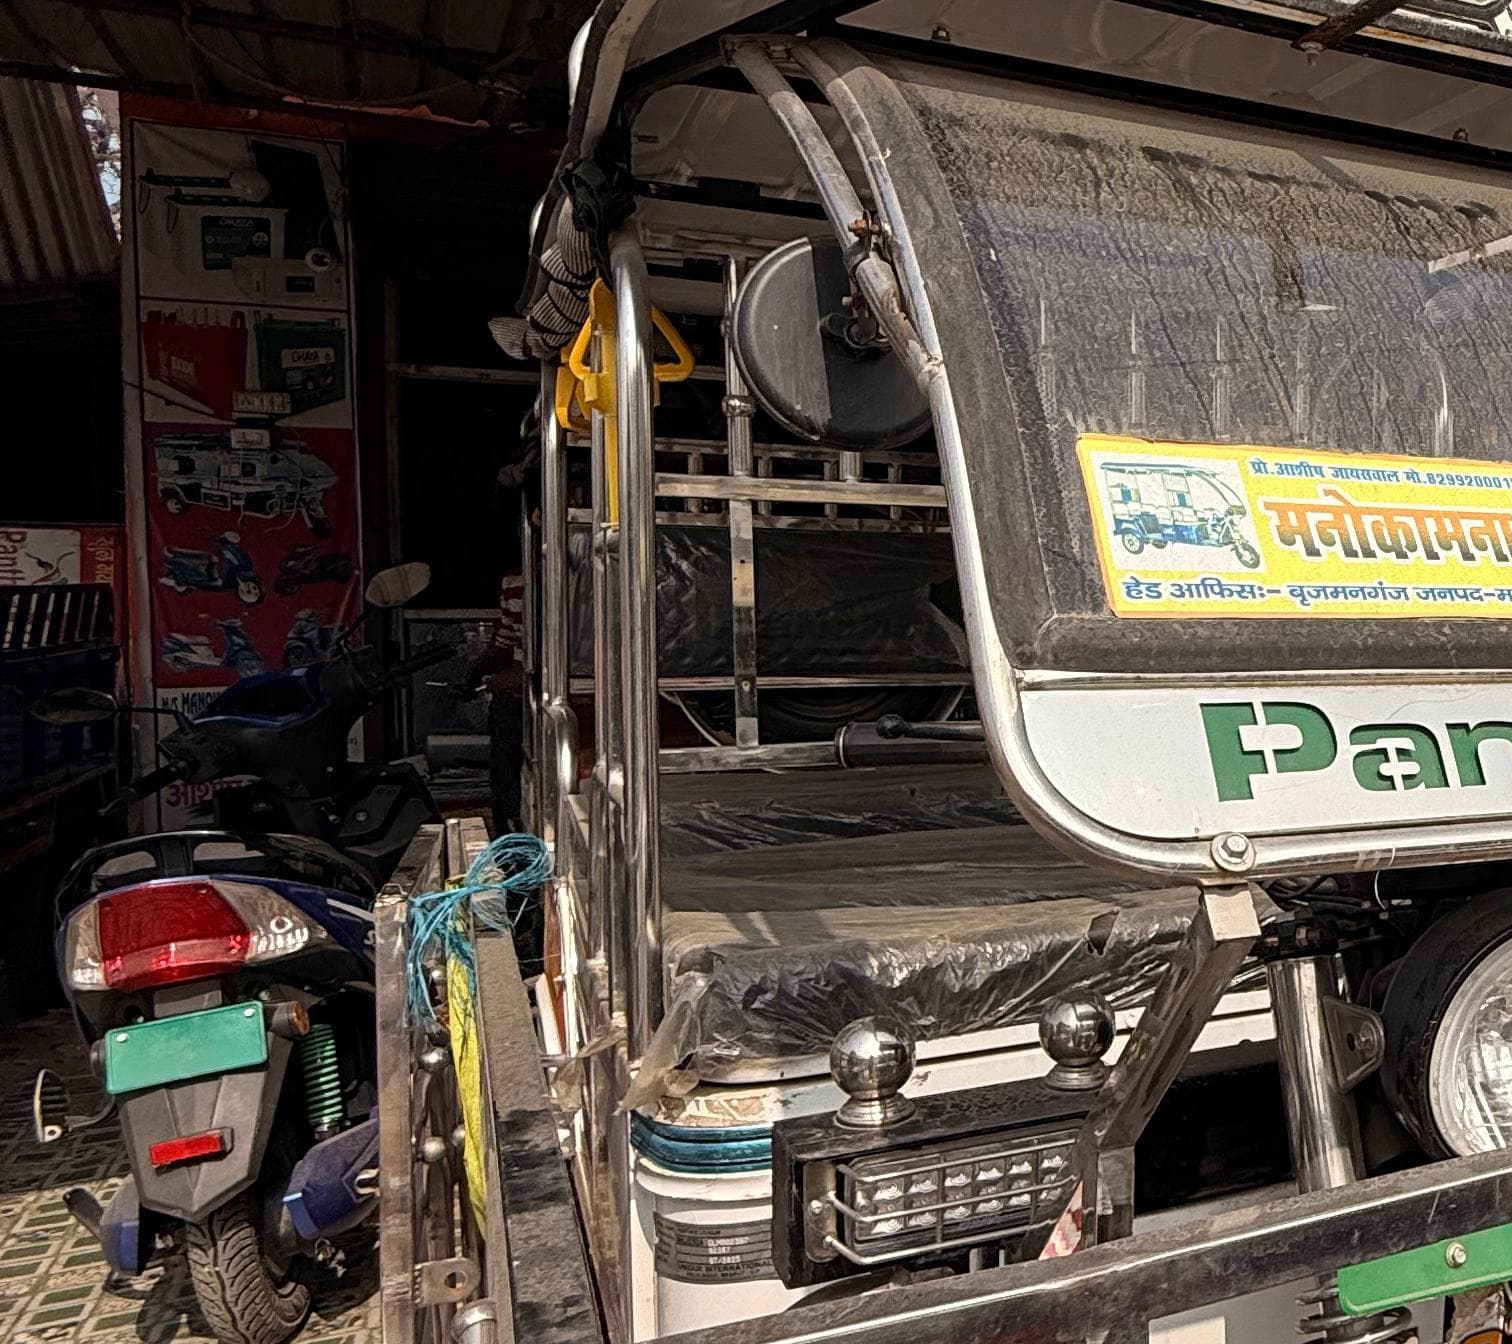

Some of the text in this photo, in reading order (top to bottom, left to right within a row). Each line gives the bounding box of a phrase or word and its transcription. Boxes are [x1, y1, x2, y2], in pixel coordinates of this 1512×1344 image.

[1328, 465, 1401, 483] जायसवाल
[1123, 576, 1163, 600] हेड
[1288, 580, 1411, 606] बृजमनगंज
